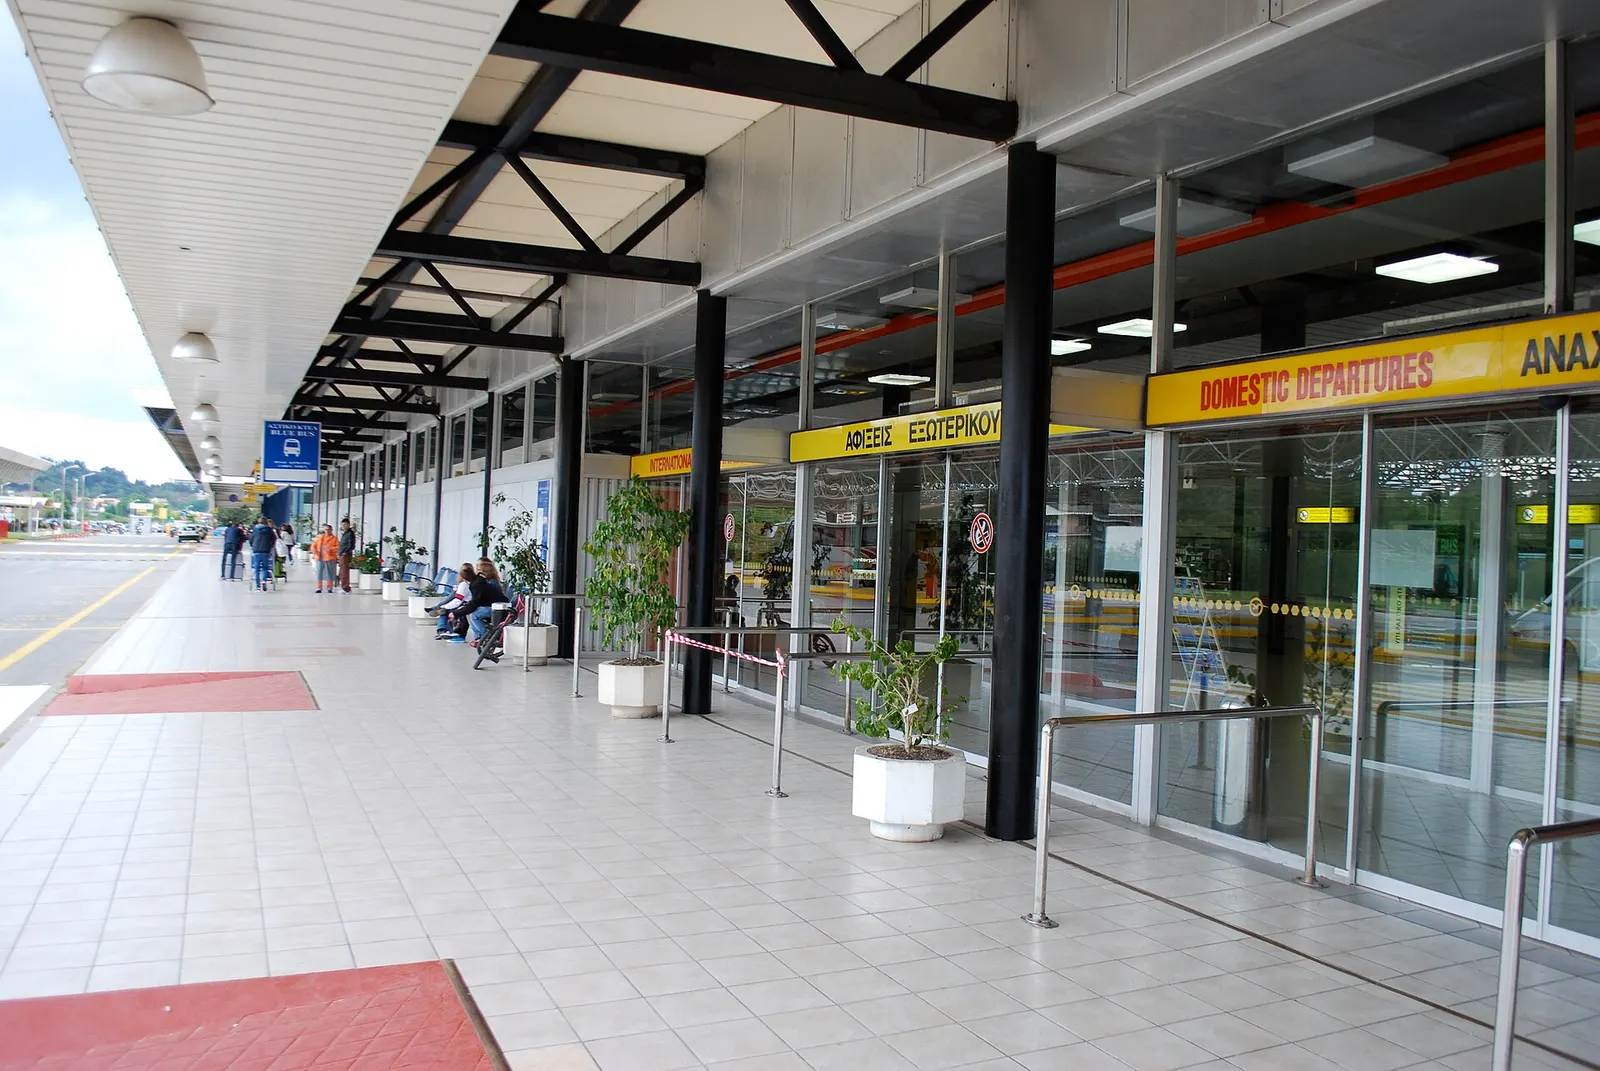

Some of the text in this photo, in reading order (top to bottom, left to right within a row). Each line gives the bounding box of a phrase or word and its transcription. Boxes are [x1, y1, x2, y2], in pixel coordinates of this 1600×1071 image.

[1200, 350, 1434, 411] DOMESTIC DEPARTURES
[845, 409, 1001, 451] ΑΦΙΞΕΙΣ ΕΞΩΤΕΡΙΚΟΥ
